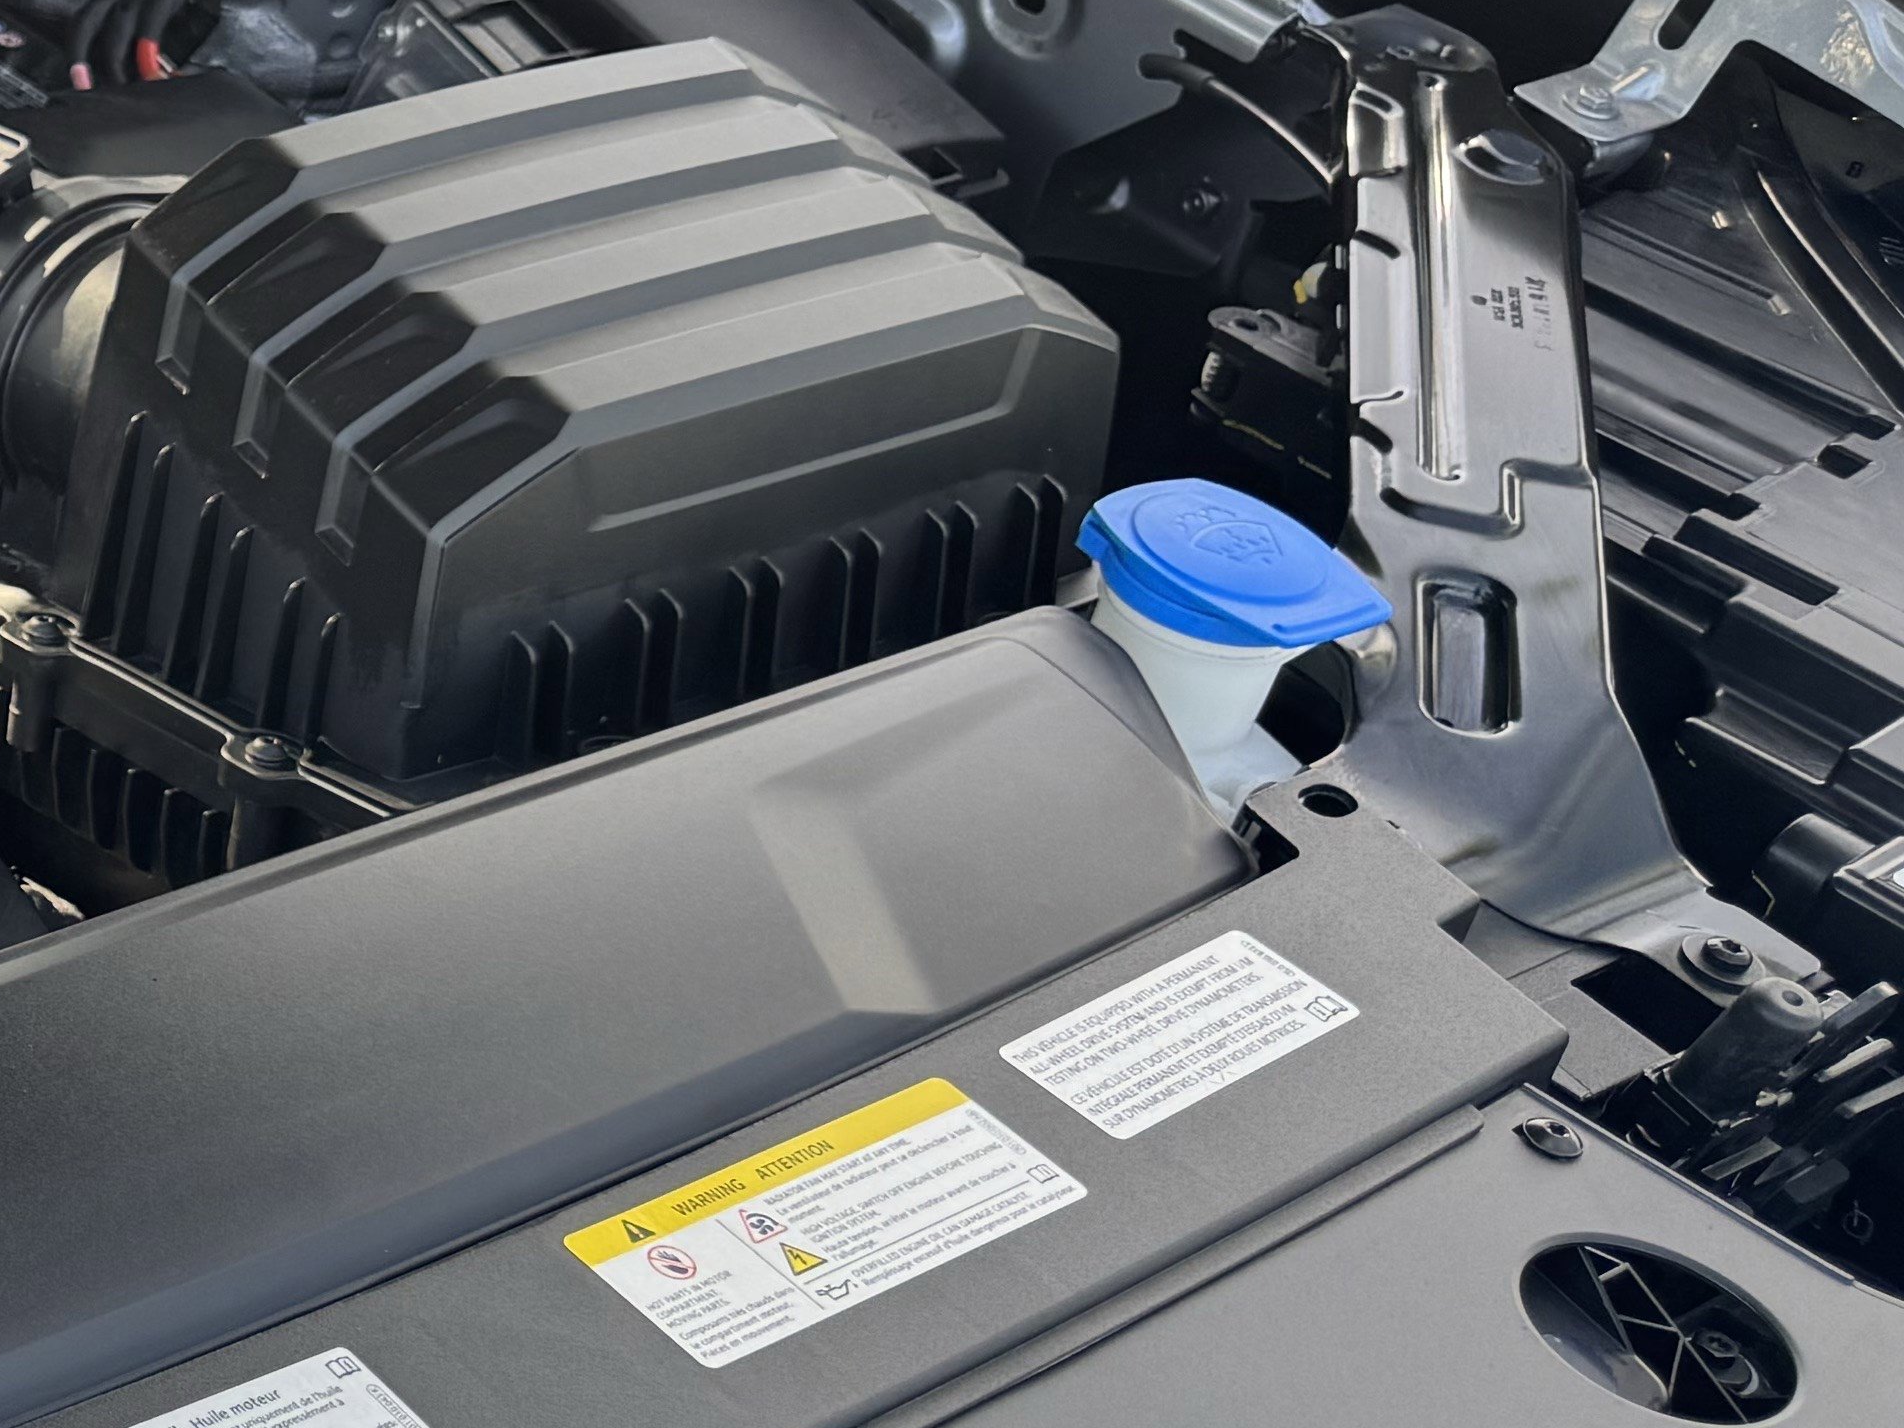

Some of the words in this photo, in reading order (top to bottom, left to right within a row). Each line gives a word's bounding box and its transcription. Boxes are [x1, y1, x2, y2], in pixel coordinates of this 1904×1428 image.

[671, 1178, 745, 1215] WARNING
[755, 1140, 833, 1179] ATTENTION
[229, 1389, 280, 1415] moteur
